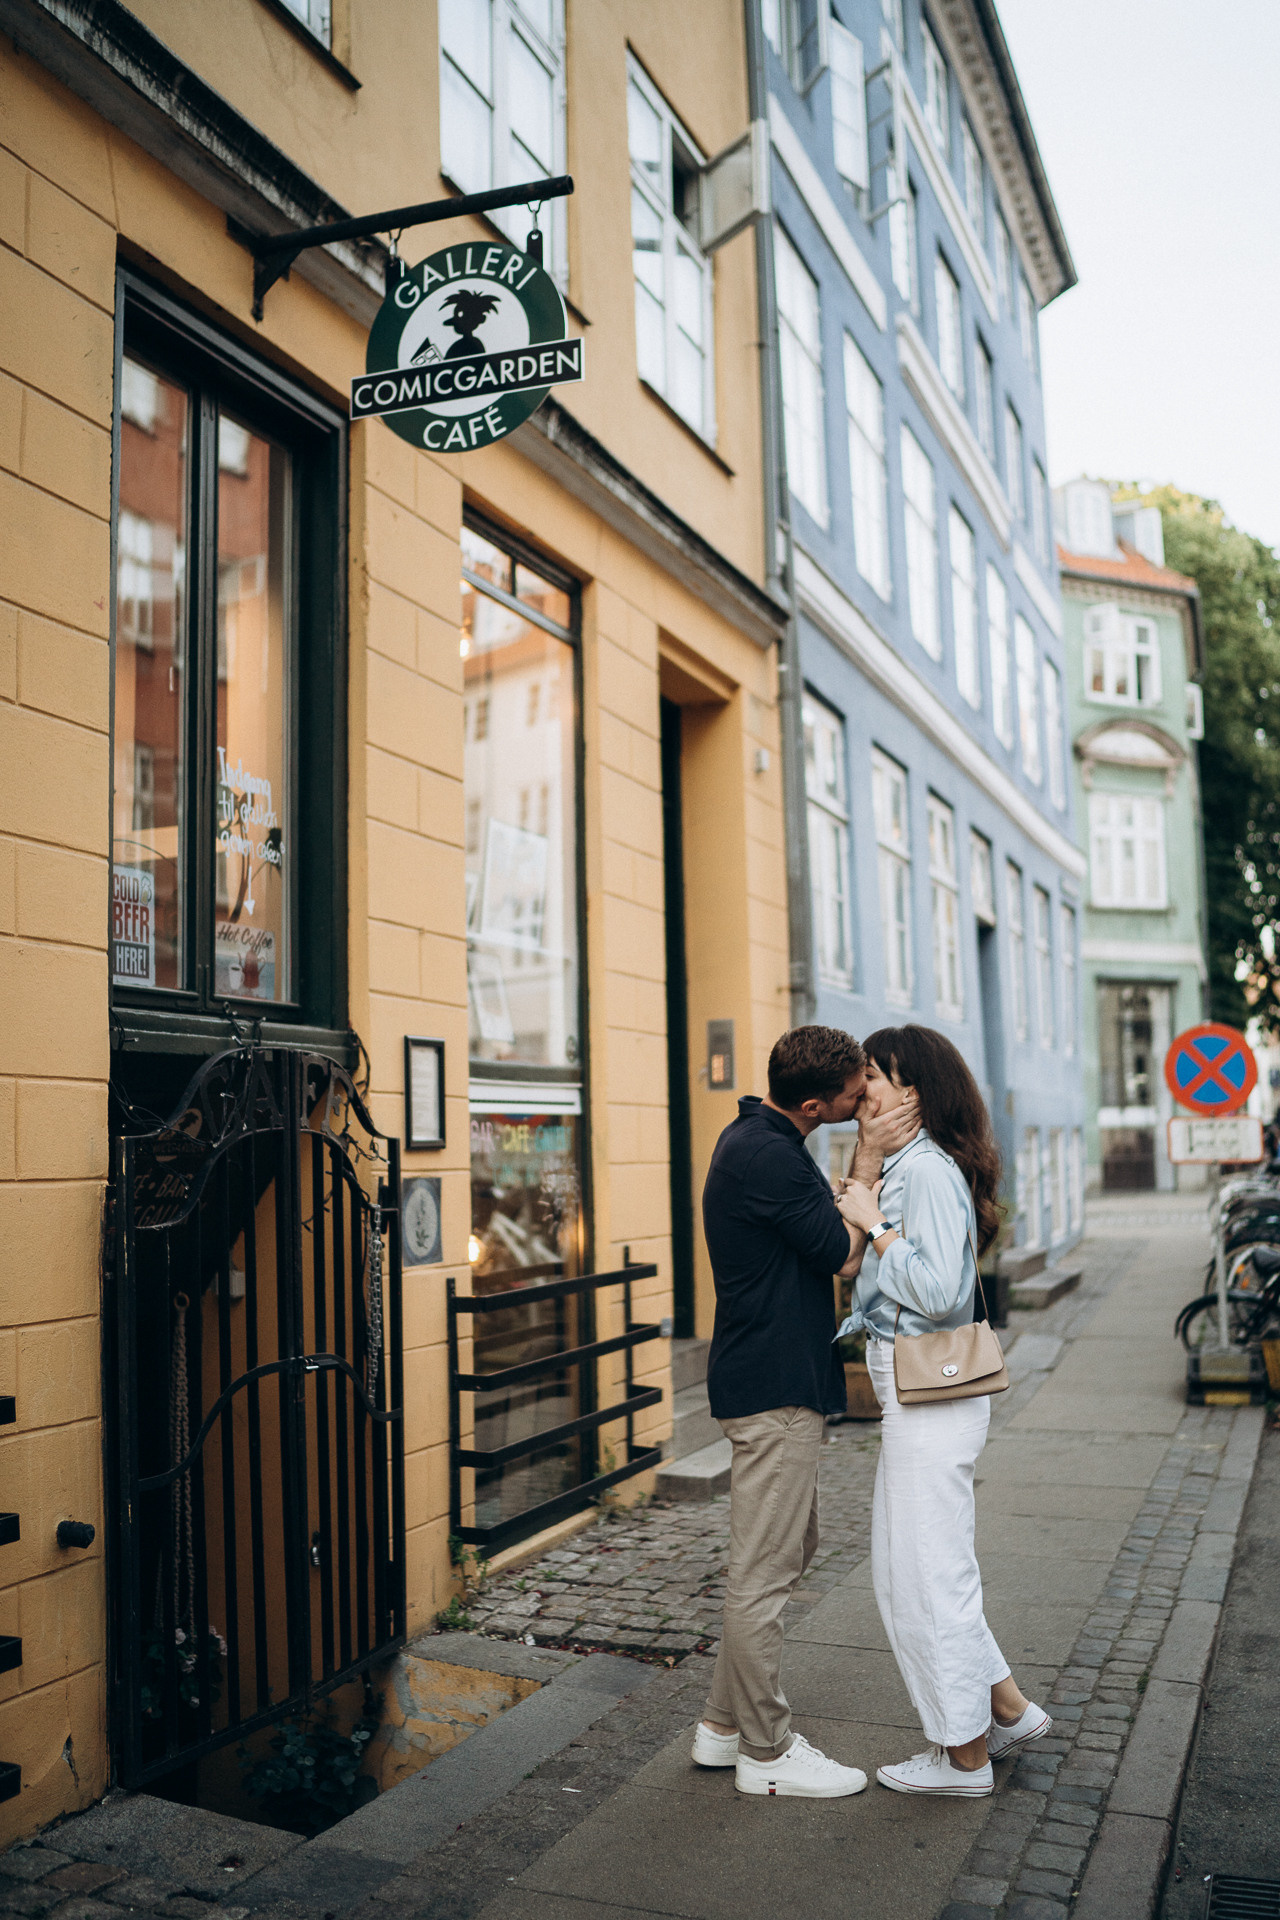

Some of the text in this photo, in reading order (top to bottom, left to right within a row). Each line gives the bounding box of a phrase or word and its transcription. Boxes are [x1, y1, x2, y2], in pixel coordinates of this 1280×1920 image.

[394, 247, 538, 309] GALLERI
[354, 347, 579, 409] COMICGARDEN
[423, 405, 507, 449] CAFÉ
[113, 873, 140, 903] COLD
[113, 900, 150, 945] BEER
[217, 923, 273, 955] Hot Coffee
[115, 944, 147, 976] HERE!
